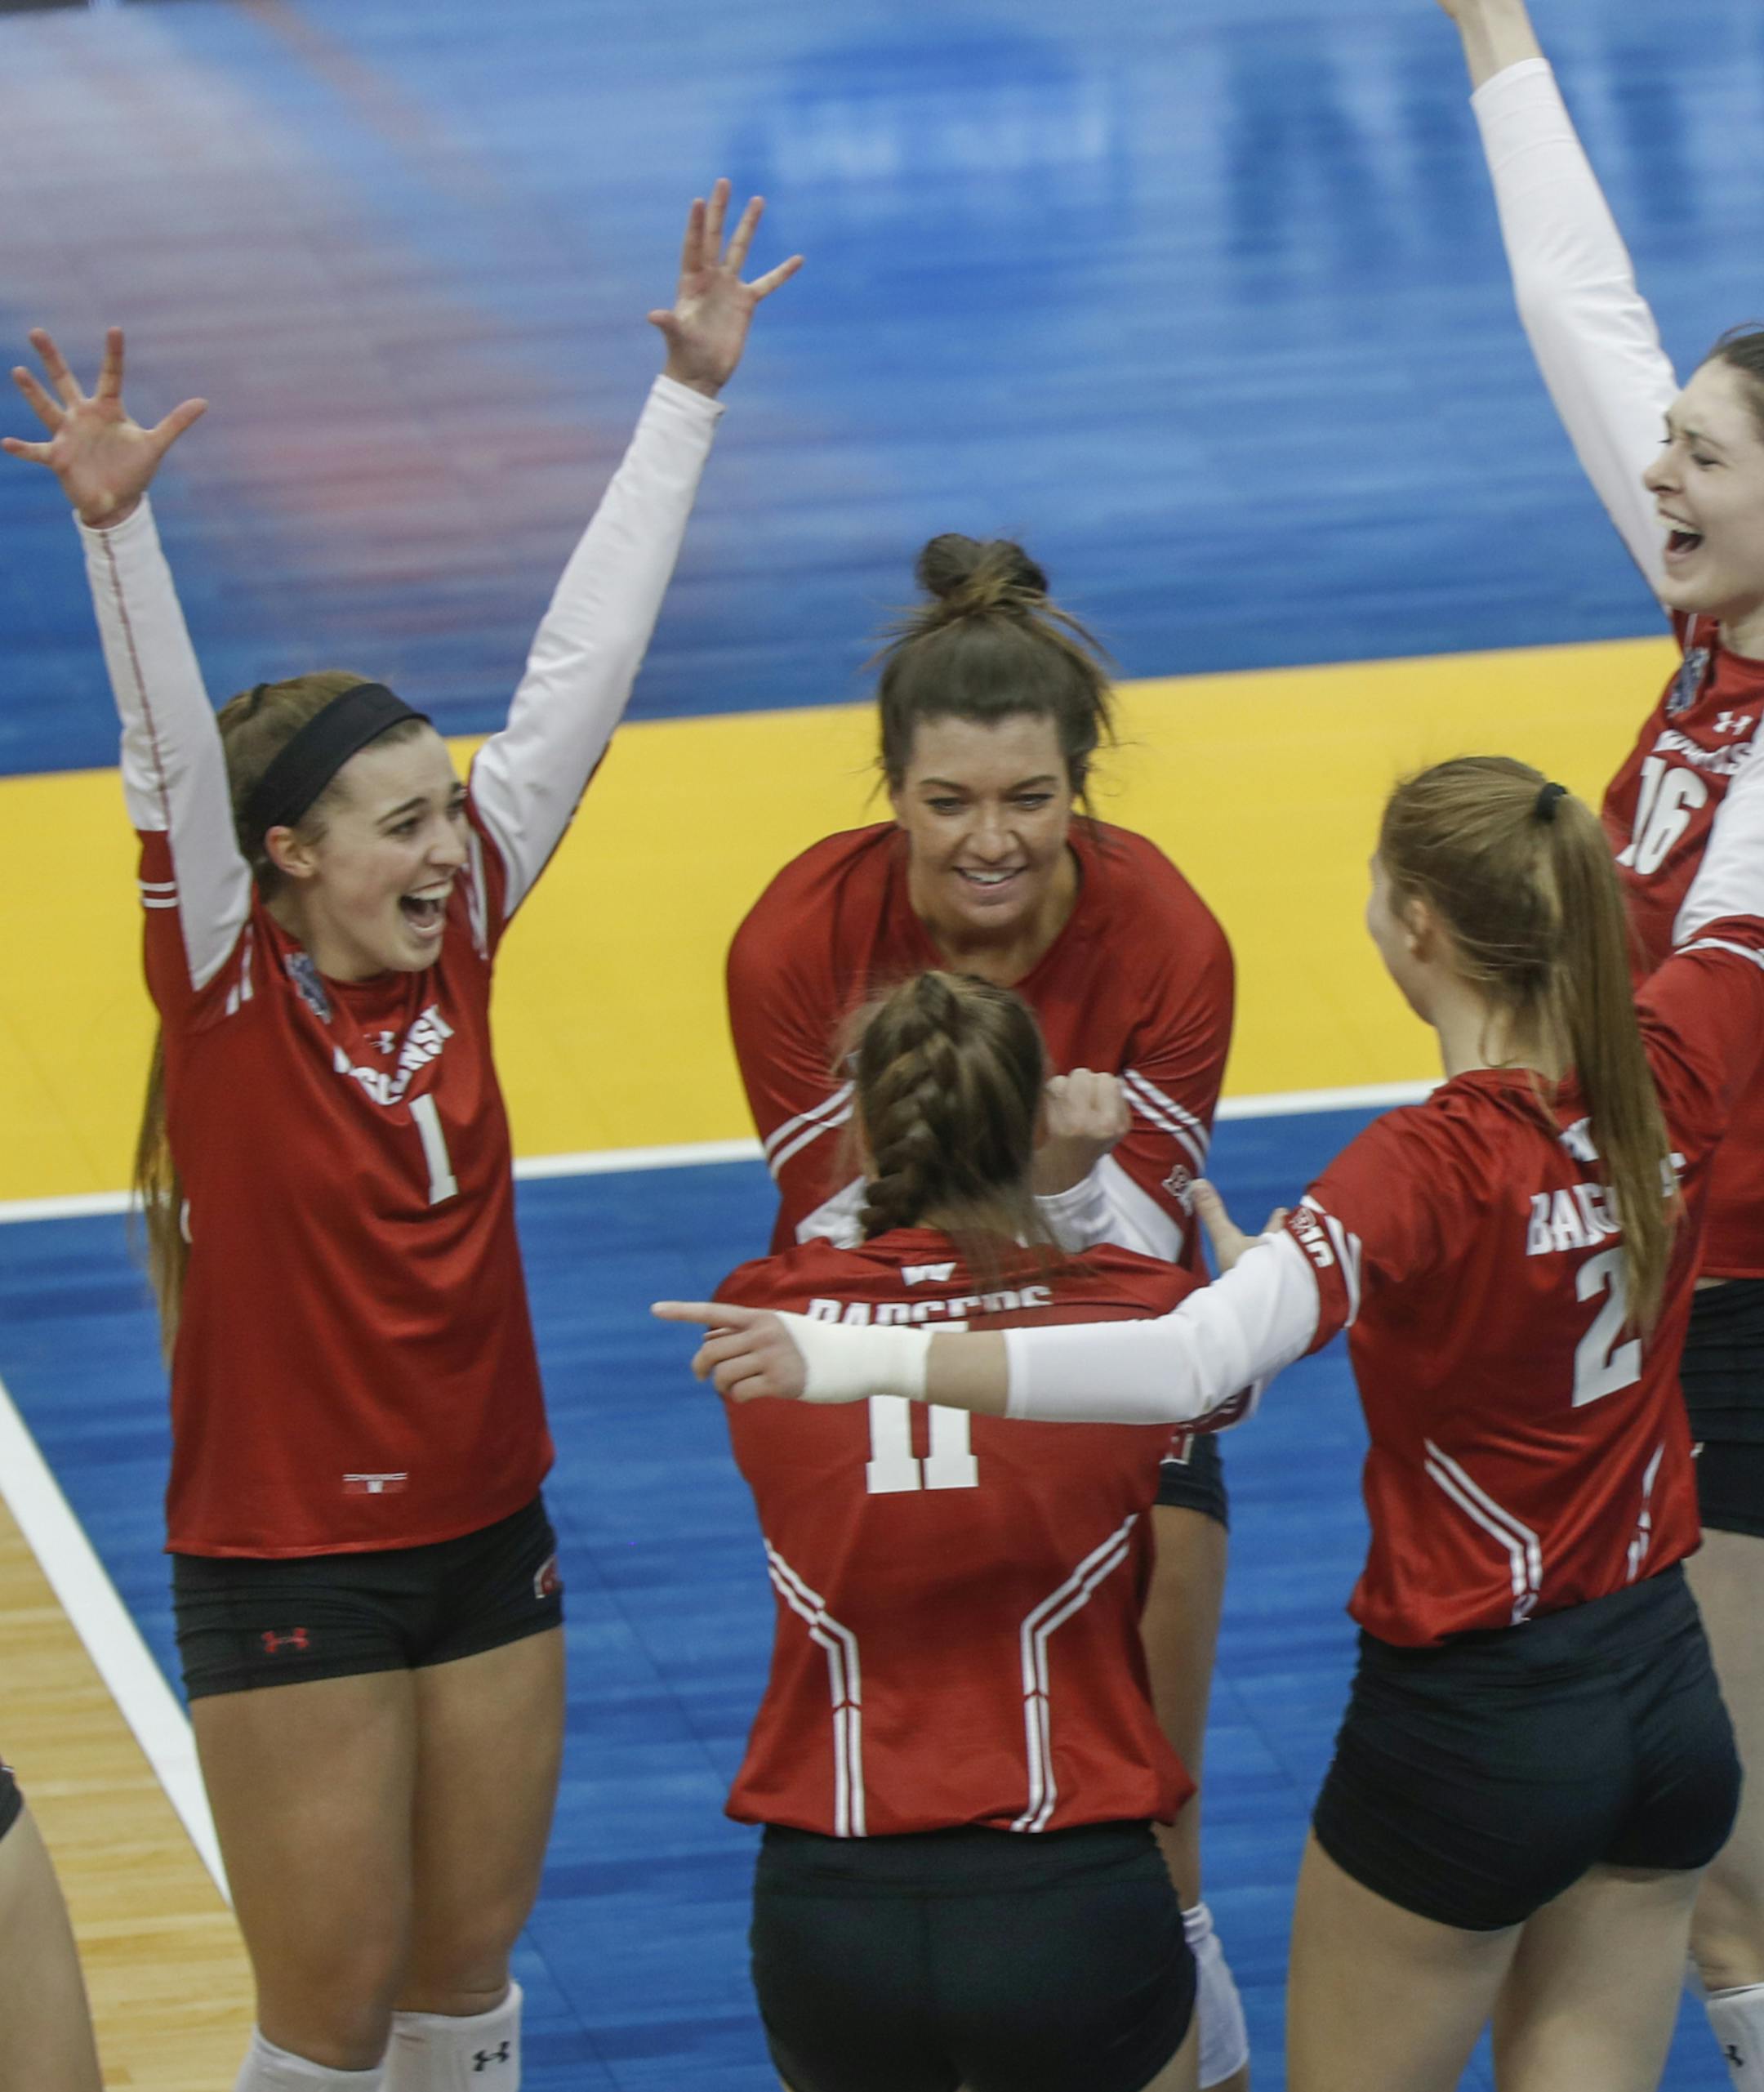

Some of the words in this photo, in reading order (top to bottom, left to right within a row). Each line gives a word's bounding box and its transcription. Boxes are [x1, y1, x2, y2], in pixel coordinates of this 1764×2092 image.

[1615, 755, 1708, 875] 16
[409, 1093, 458, 1205] 1
[1571, 1247, 1642, 1407] 2
[866, 1321, 979, 1494] 11
